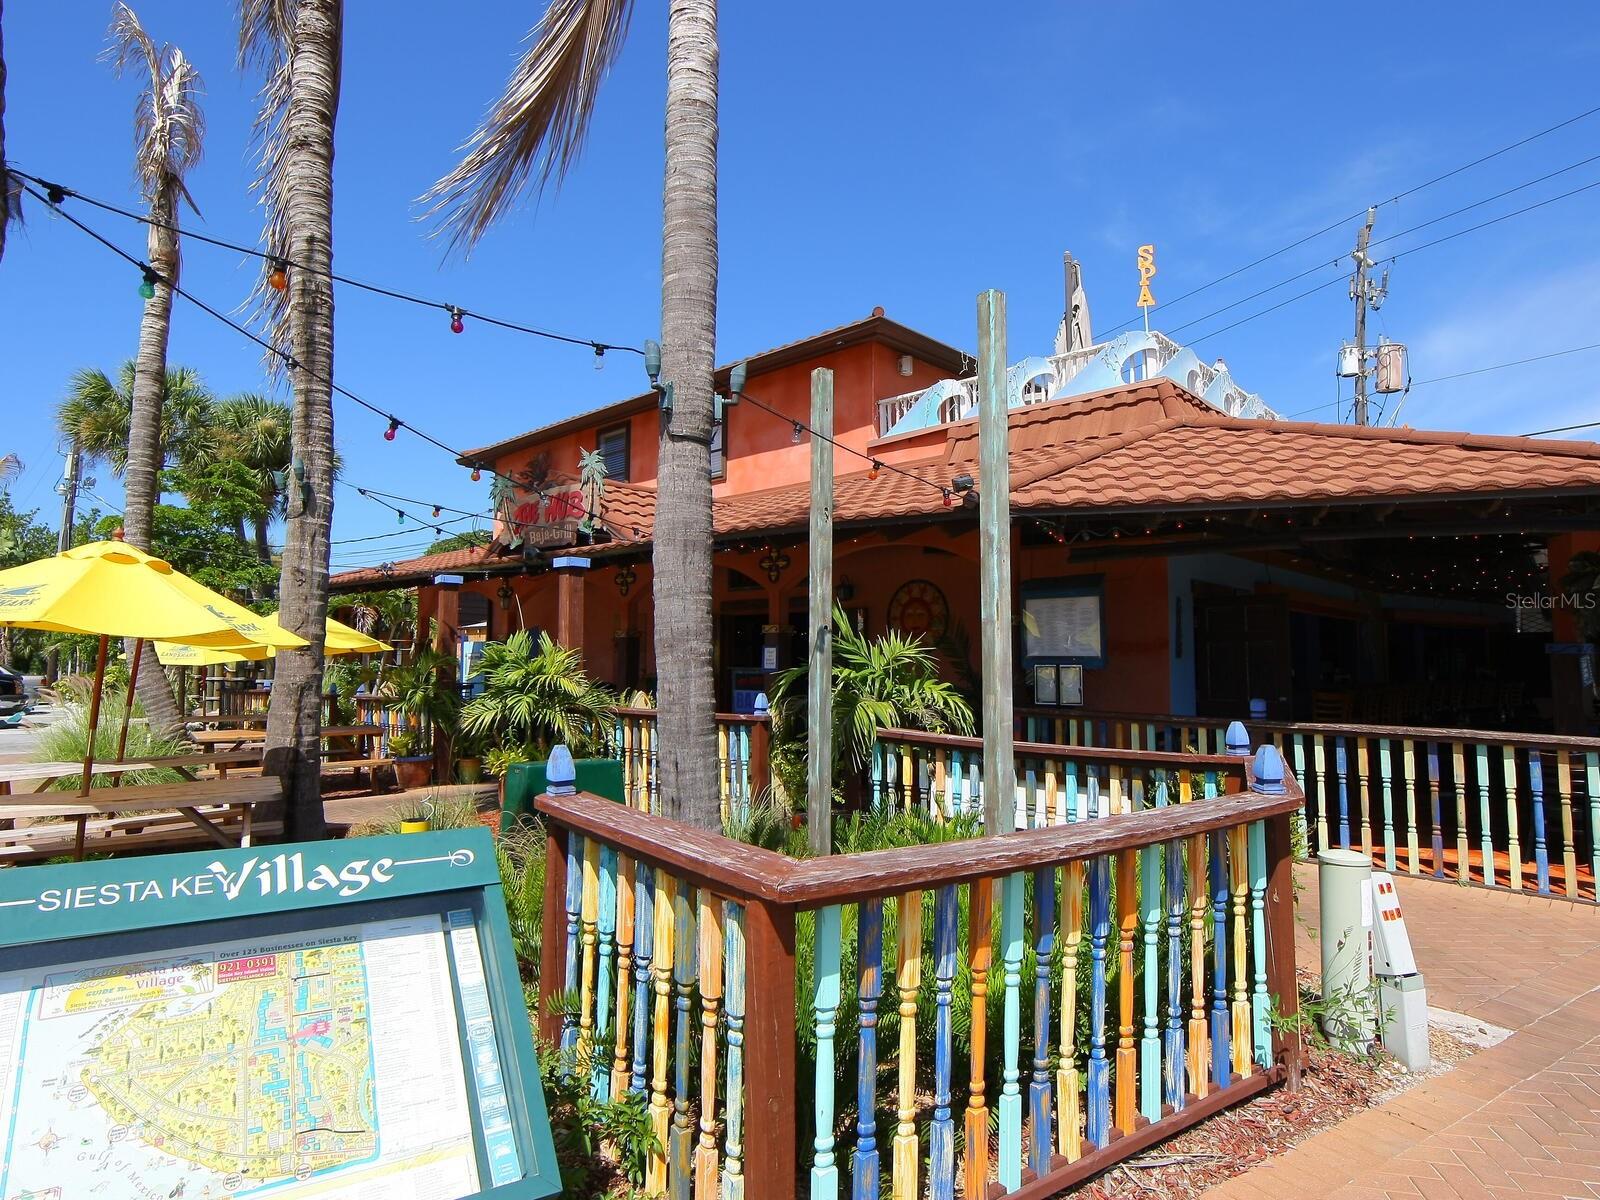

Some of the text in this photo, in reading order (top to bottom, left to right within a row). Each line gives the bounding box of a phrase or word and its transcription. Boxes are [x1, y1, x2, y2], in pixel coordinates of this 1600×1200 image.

[1137, 244, 1156, 307] SPA
[513, 490, 585, 530] THE HUB
[529, 523, 572, 545] Baja-Grill
[205, 852, 396, 899] Village
[36, 870, 237, 912] SIESTA KEY
[219, 950, 239, 959] Over
[242, 948, 257, 956] 125
[260, 942, 304, 953] Businesses
[317, 936, 342, 945] Siesta
[343, 934, 358, 943] Key
[219, 956, 275, 972] 921-0391
[136, 974, 184, 990] Village
[76, 1150, 113, 1167] Gulf
